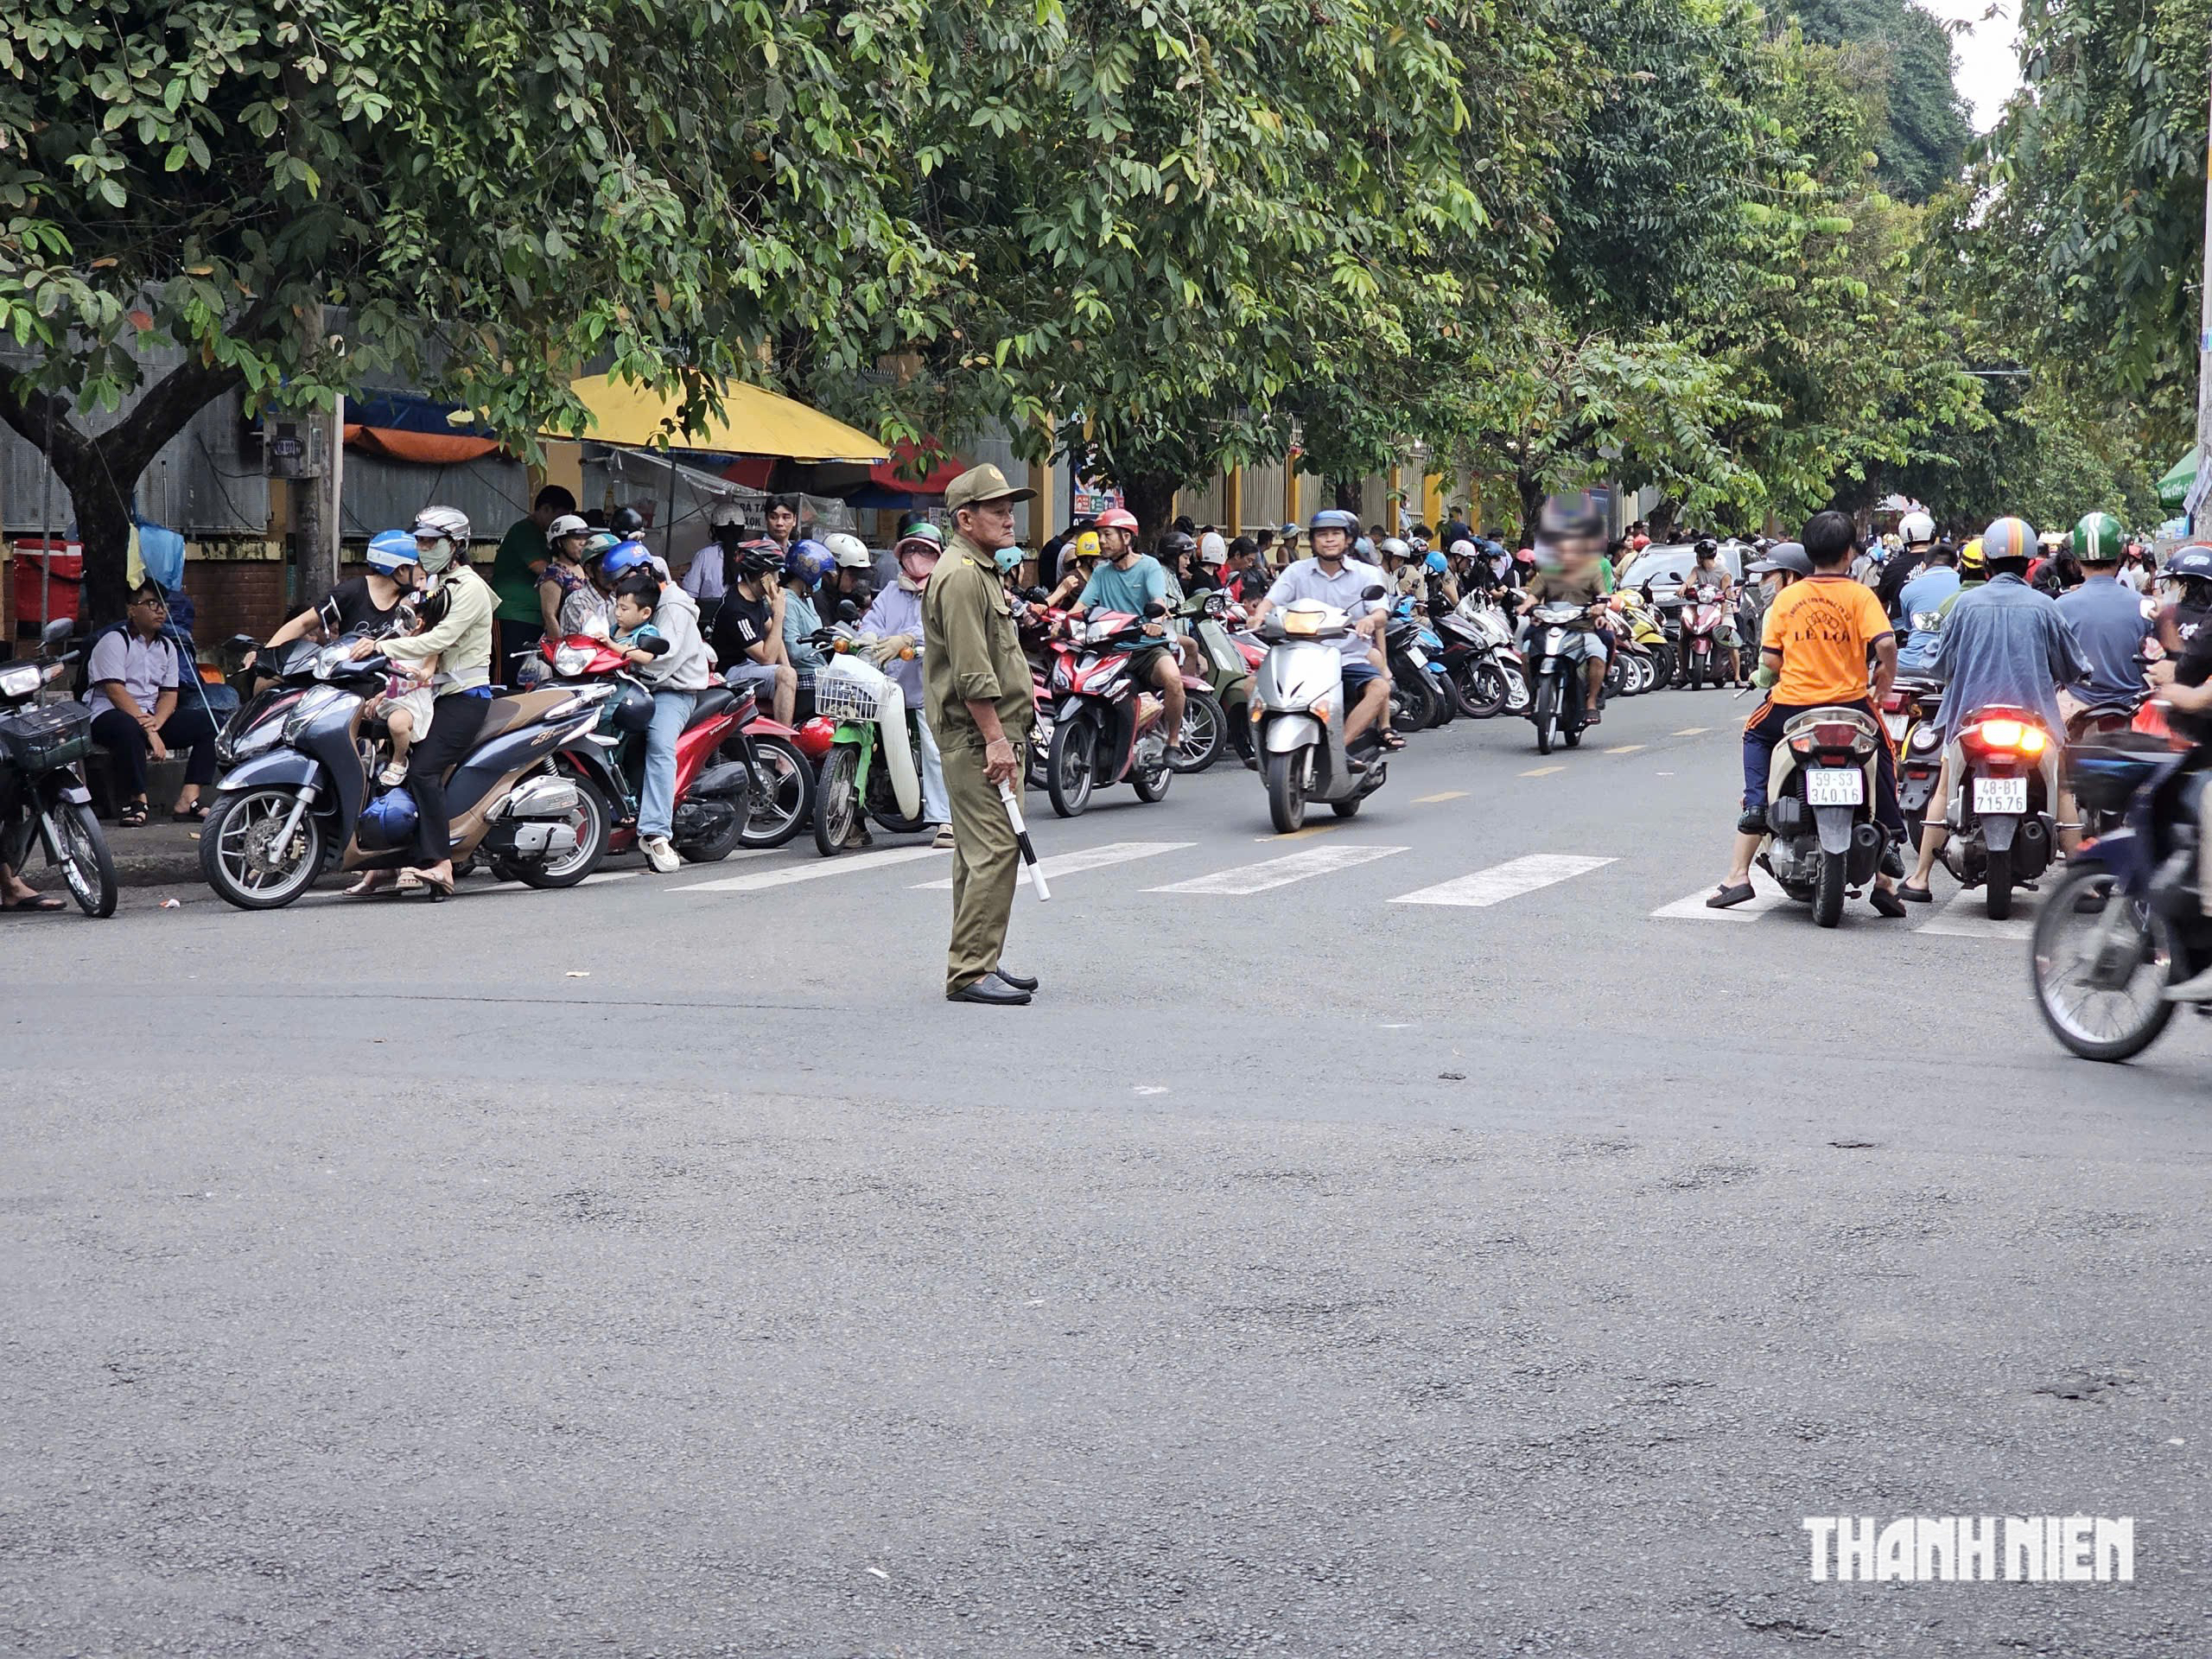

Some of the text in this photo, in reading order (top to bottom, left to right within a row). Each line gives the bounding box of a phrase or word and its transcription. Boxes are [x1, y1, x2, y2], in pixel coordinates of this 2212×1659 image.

[1815, 772, 1853, 786] 59-S3
[1982, 780, 2018, 795] 48-B1
[1811, 788, 1859, 803] 340.16
[1977, 797, 2023, 810] 715.76
